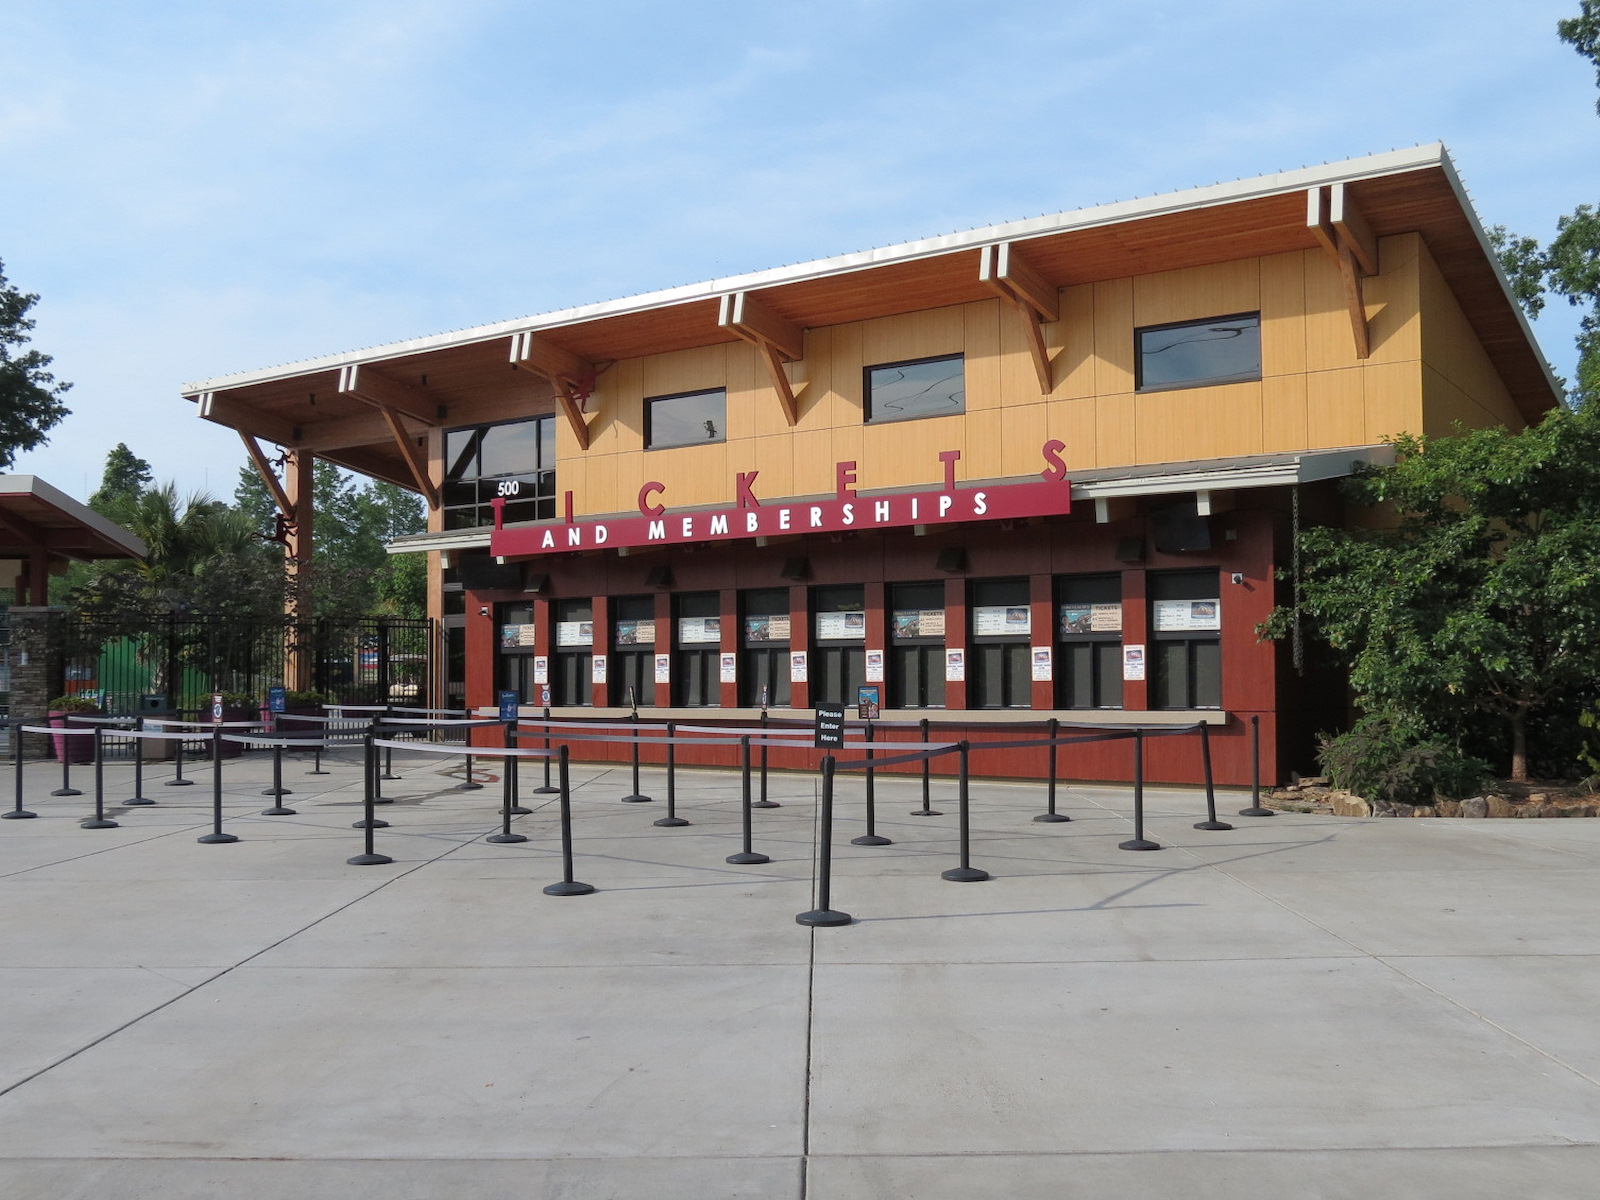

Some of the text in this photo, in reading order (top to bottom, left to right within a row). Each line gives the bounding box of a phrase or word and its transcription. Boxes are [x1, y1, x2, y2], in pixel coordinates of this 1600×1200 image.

[490, 439, 1067, 530] TICKETS
[497, 480, 520, 497] 500
[541, 492, 988, 549] AND MEMBERSHIPS
[818, 709, 843, 718] Please
[820, 722, 840, 730] Enter
[820, 734, 838, 742] Here
